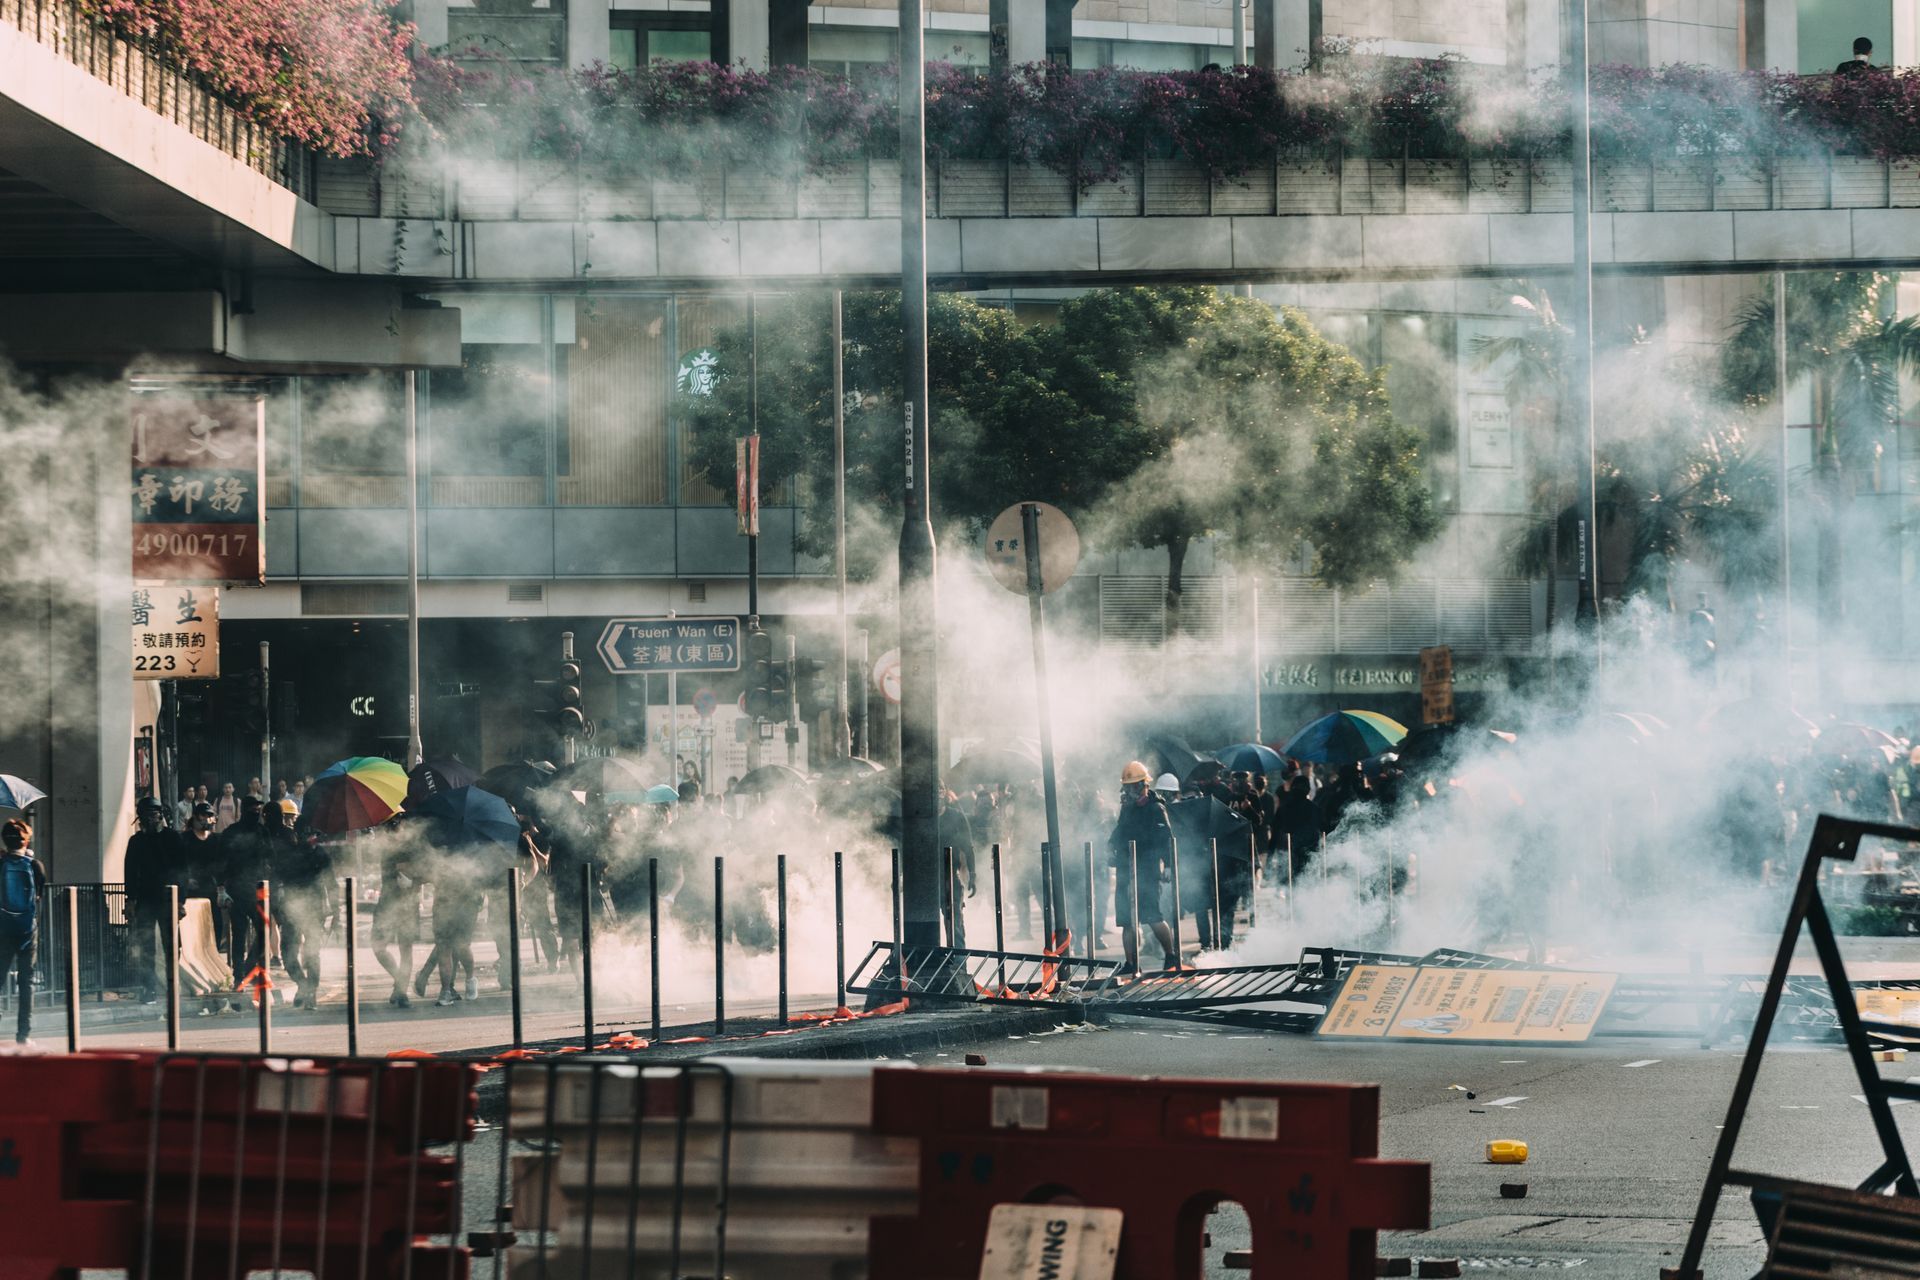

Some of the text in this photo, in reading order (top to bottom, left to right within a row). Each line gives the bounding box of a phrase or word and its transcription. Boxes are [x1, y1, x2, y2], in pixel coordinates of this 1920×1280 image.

[136, 533, 247, 557] 4900717
[132, 589, 203, 626] 醫生
[628, 624, 733, 638] Tsuen Wan (E)
[135, 655, 177, 671] 223
[633, 643, 734, 664] 荃灣(東區)
